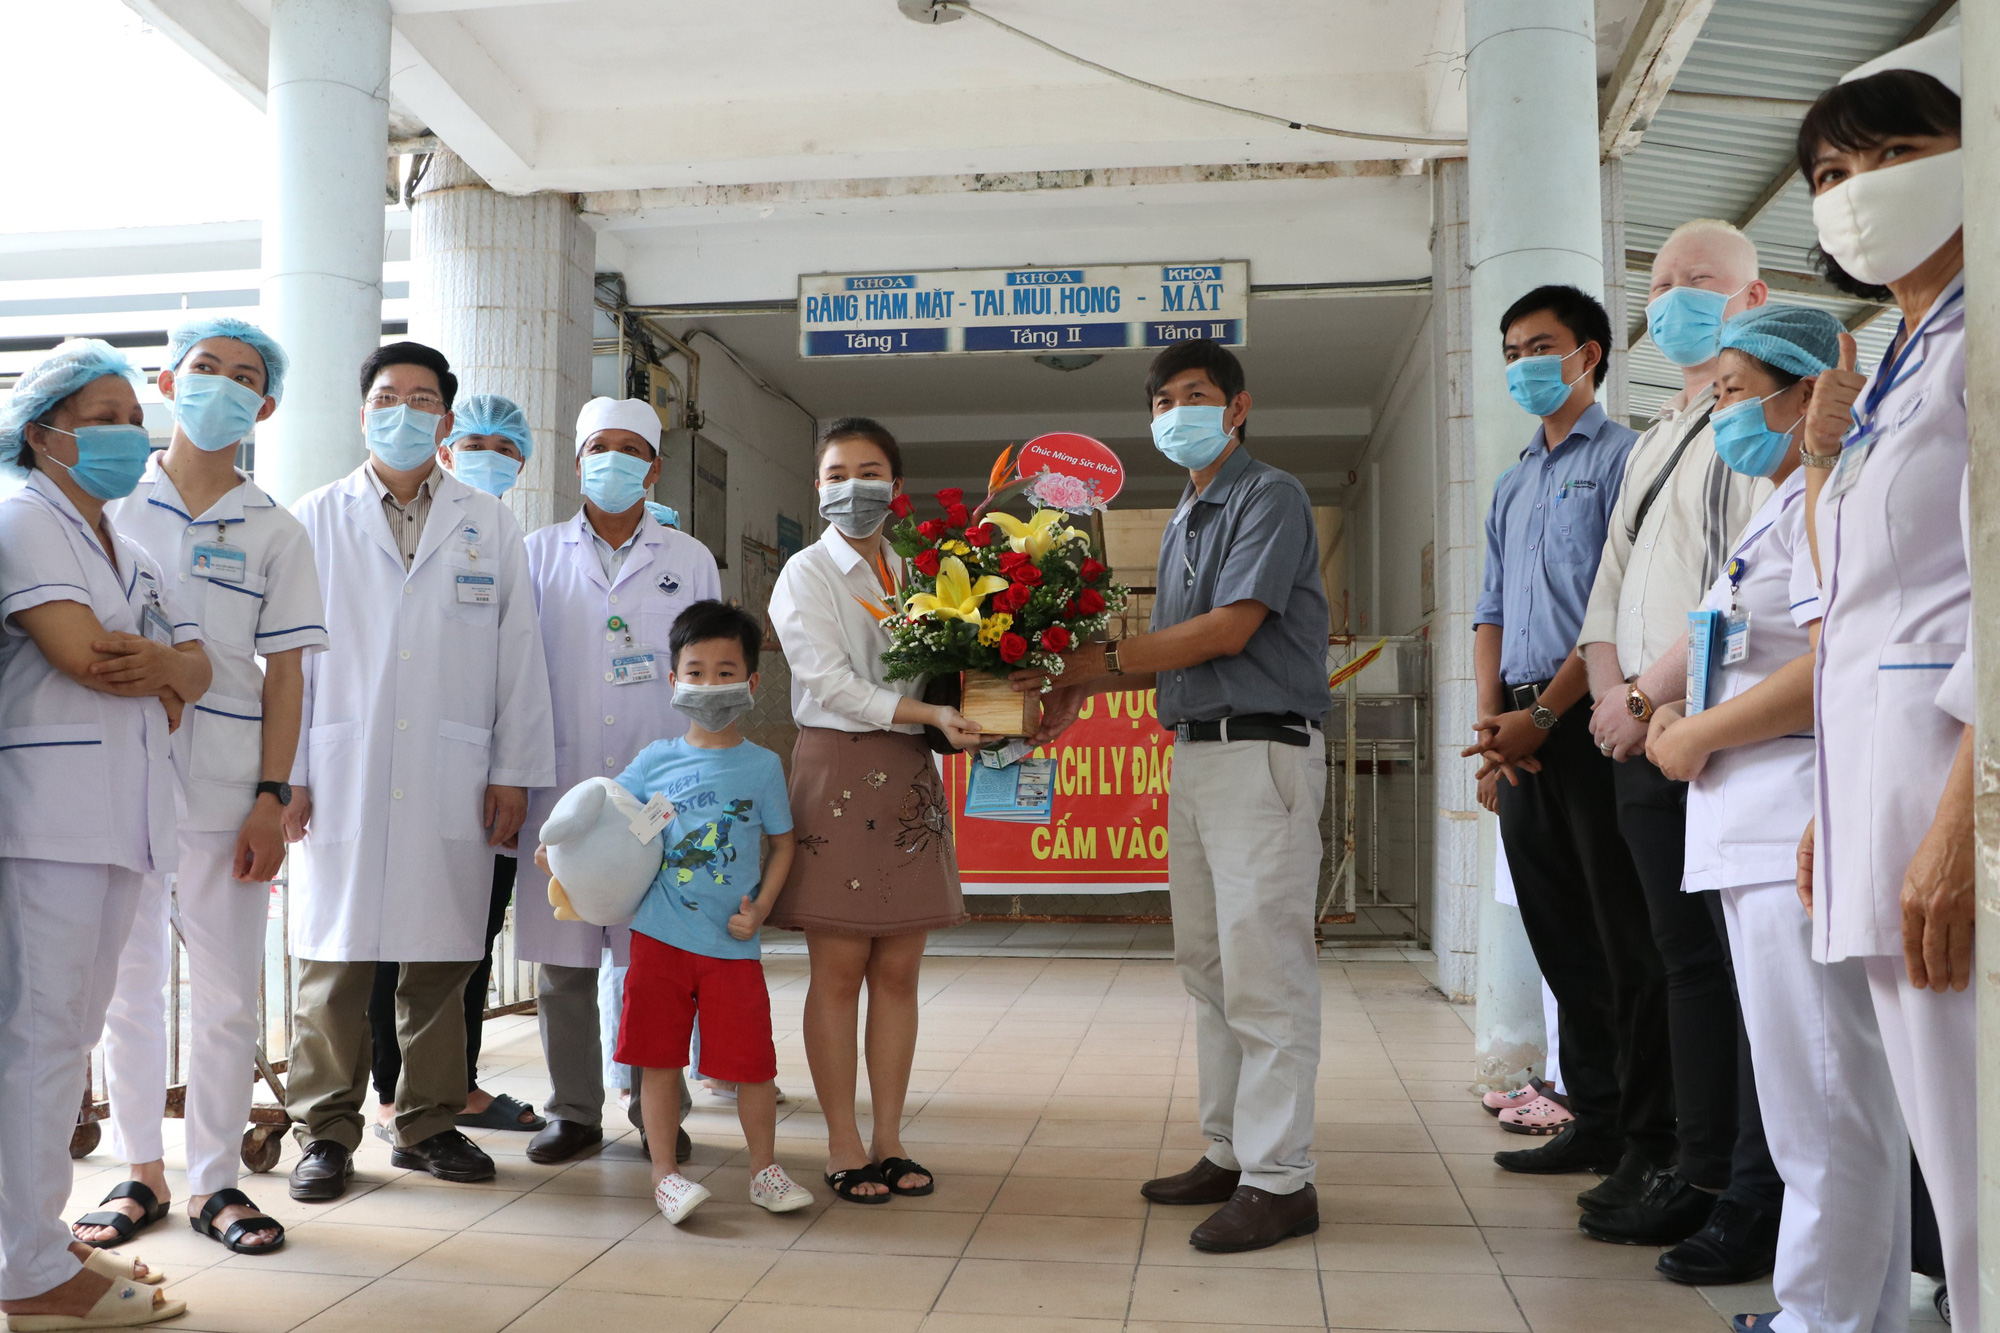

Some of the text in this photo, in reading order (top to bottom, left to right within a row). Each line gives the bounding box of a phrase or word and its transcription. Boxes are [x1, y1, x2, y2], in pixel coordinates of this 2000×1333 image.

[1016, 272, 1073, 284] KHOA
[1168, 268, 1216, 280] KHOA
[853, 278, 907, 289] KHOA
[915, 288, 955, 320] MẶT
[1060, 286, 1121, 317] HỌNG
[1066, 327, 1082, 342] II
[1210, 323, 1226, 339] III
[900, 332, 909, 347] I
[1031, 445, 1118, 475] Chúc Mừng Sức Khỏe
[1099, 746, 1126, 795] LY
[1031, 813, 1169, 860] CẤM VÀO
